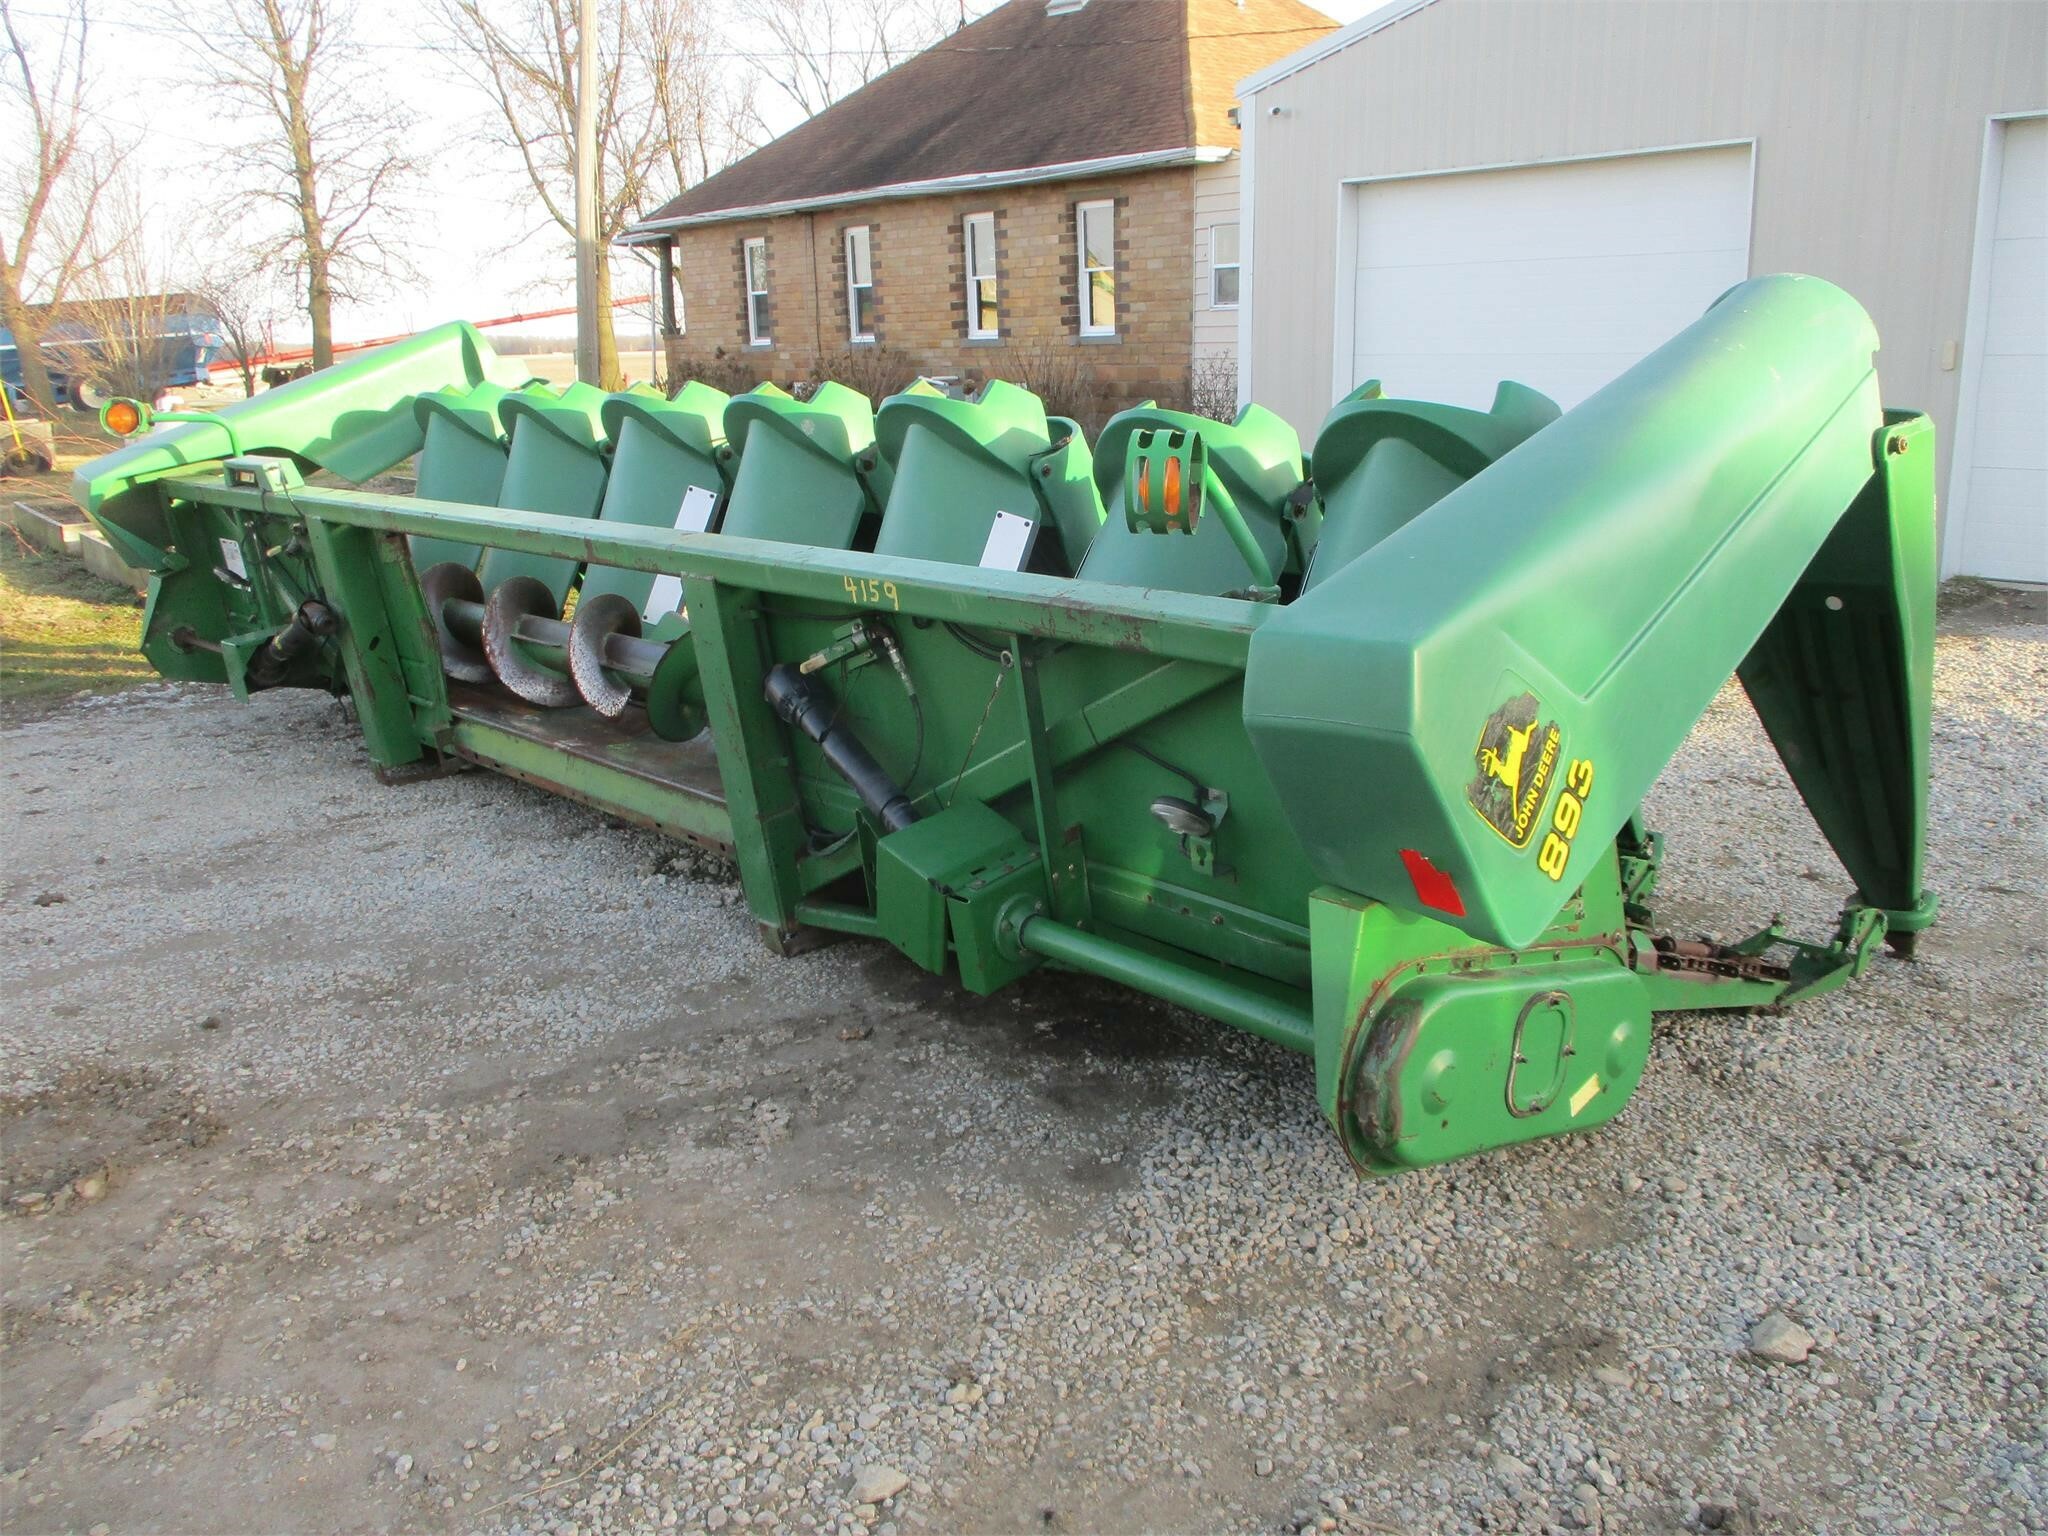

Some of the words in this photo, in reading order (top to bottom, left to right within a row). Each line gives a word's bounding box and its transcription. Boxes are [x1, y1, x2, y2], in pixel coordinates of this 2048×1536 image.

[843, 575, 899, 611] 4159
[1514, 788, 1539, 839] JOHN
[1534, 728, 1560, 788] DEERE
[1538, 759, 1593, 881] 893
